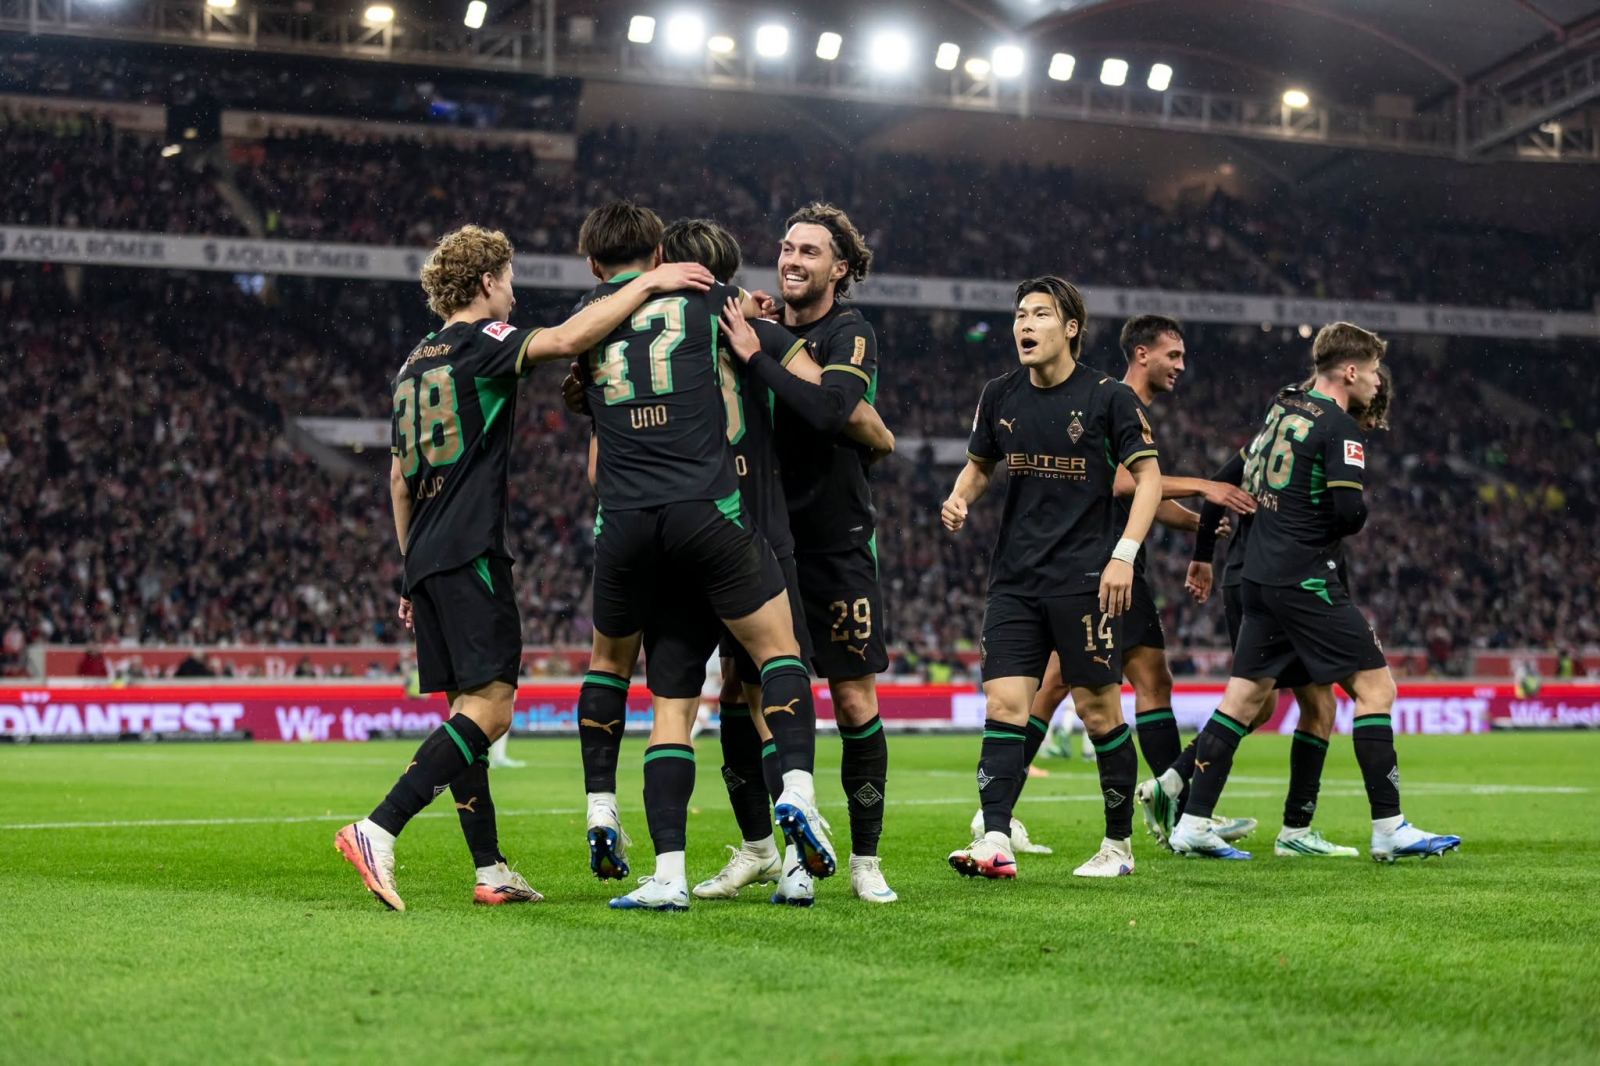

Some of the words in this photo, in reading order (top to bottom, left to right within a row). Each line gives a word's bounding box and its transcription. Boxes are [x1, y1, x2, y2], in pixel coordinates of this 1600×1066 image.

[590, 296, 689, 406] 47
[393, 365, 465, 478] 38
[630, 404, 668, 430] UNO
[829, 598, 872, 642] 29
[1081, 612, 1114, 652] 14
[275, 706, 336, 742] Wir
